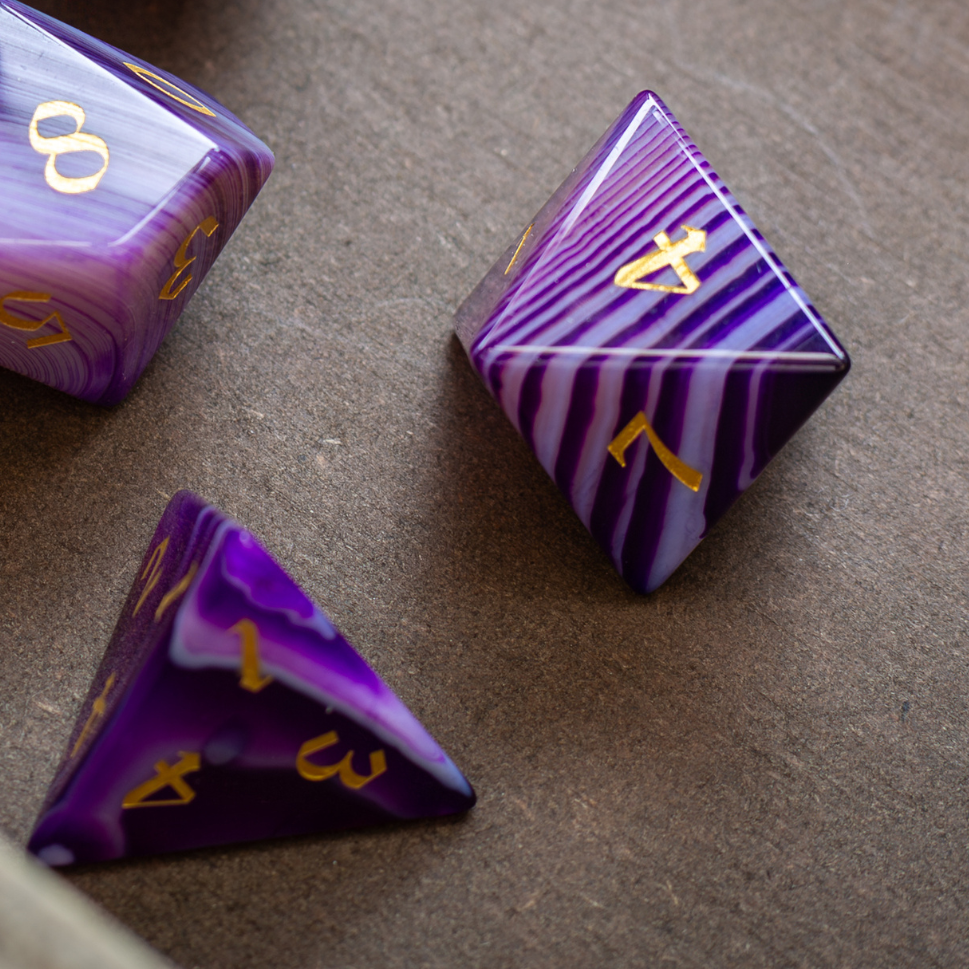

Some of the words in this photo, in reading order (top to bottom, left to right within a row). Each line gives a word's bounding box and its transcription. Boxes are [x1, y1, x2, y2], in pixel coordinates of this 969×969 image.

[29, 100, 110, 195] 8
[158, 215, 220, 301] 3
[613, 224, 707, 295] 4
[607, 409, 704, 493] 7
[226, 617, 274, 694] 1
[122, 749, 201, 810] 4
[295, 730, 388, 790] 3
